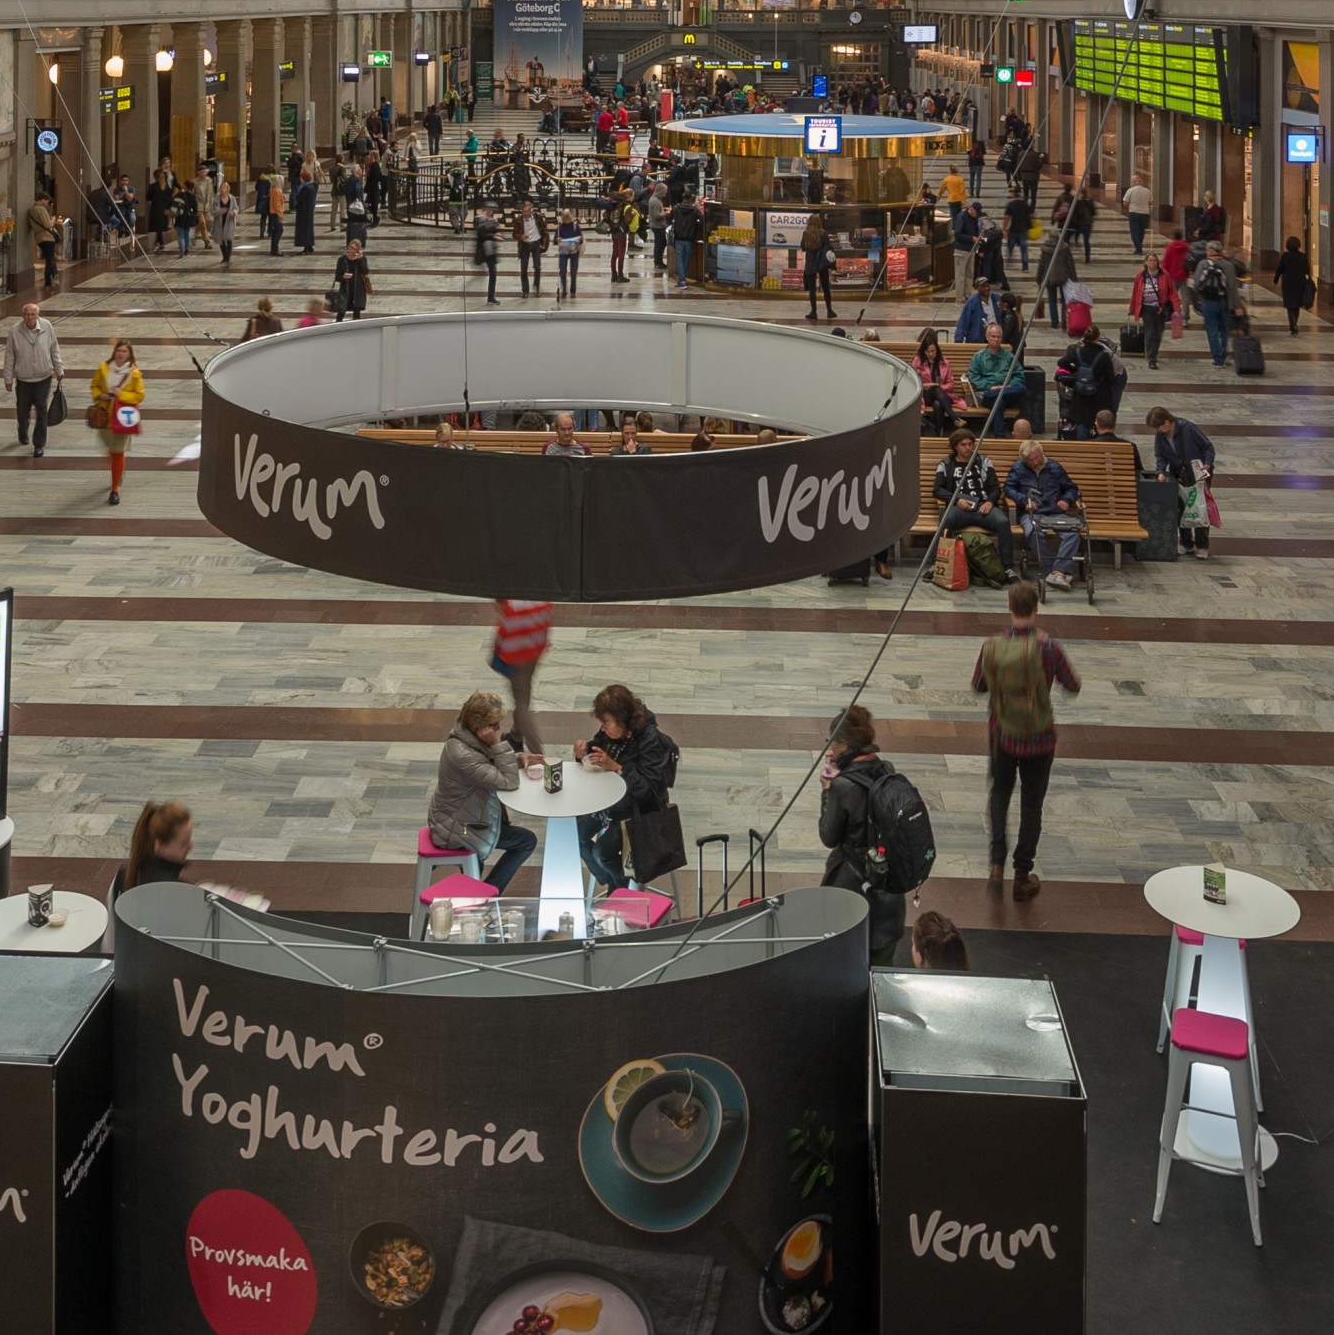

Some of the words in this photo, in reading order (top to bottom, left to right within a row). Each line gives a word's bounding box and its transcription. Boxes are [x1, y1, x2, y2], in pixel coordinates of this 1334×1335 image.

[515, 3, 554, 15] Göteborg
[554, 3, 560, 12] C
[533, 87, 541, 95] SJ
[687, 137, 721, 149] TICKETS
[925, 139, 954, 150] TICKETS
[770, 215, 808, 225] CAR2GO
[172, 1053, 545, 1167] Yoghurteria
[189, 1236, 309, 1272] Provsmaka
[227, 1276, 273, 1303] här!
